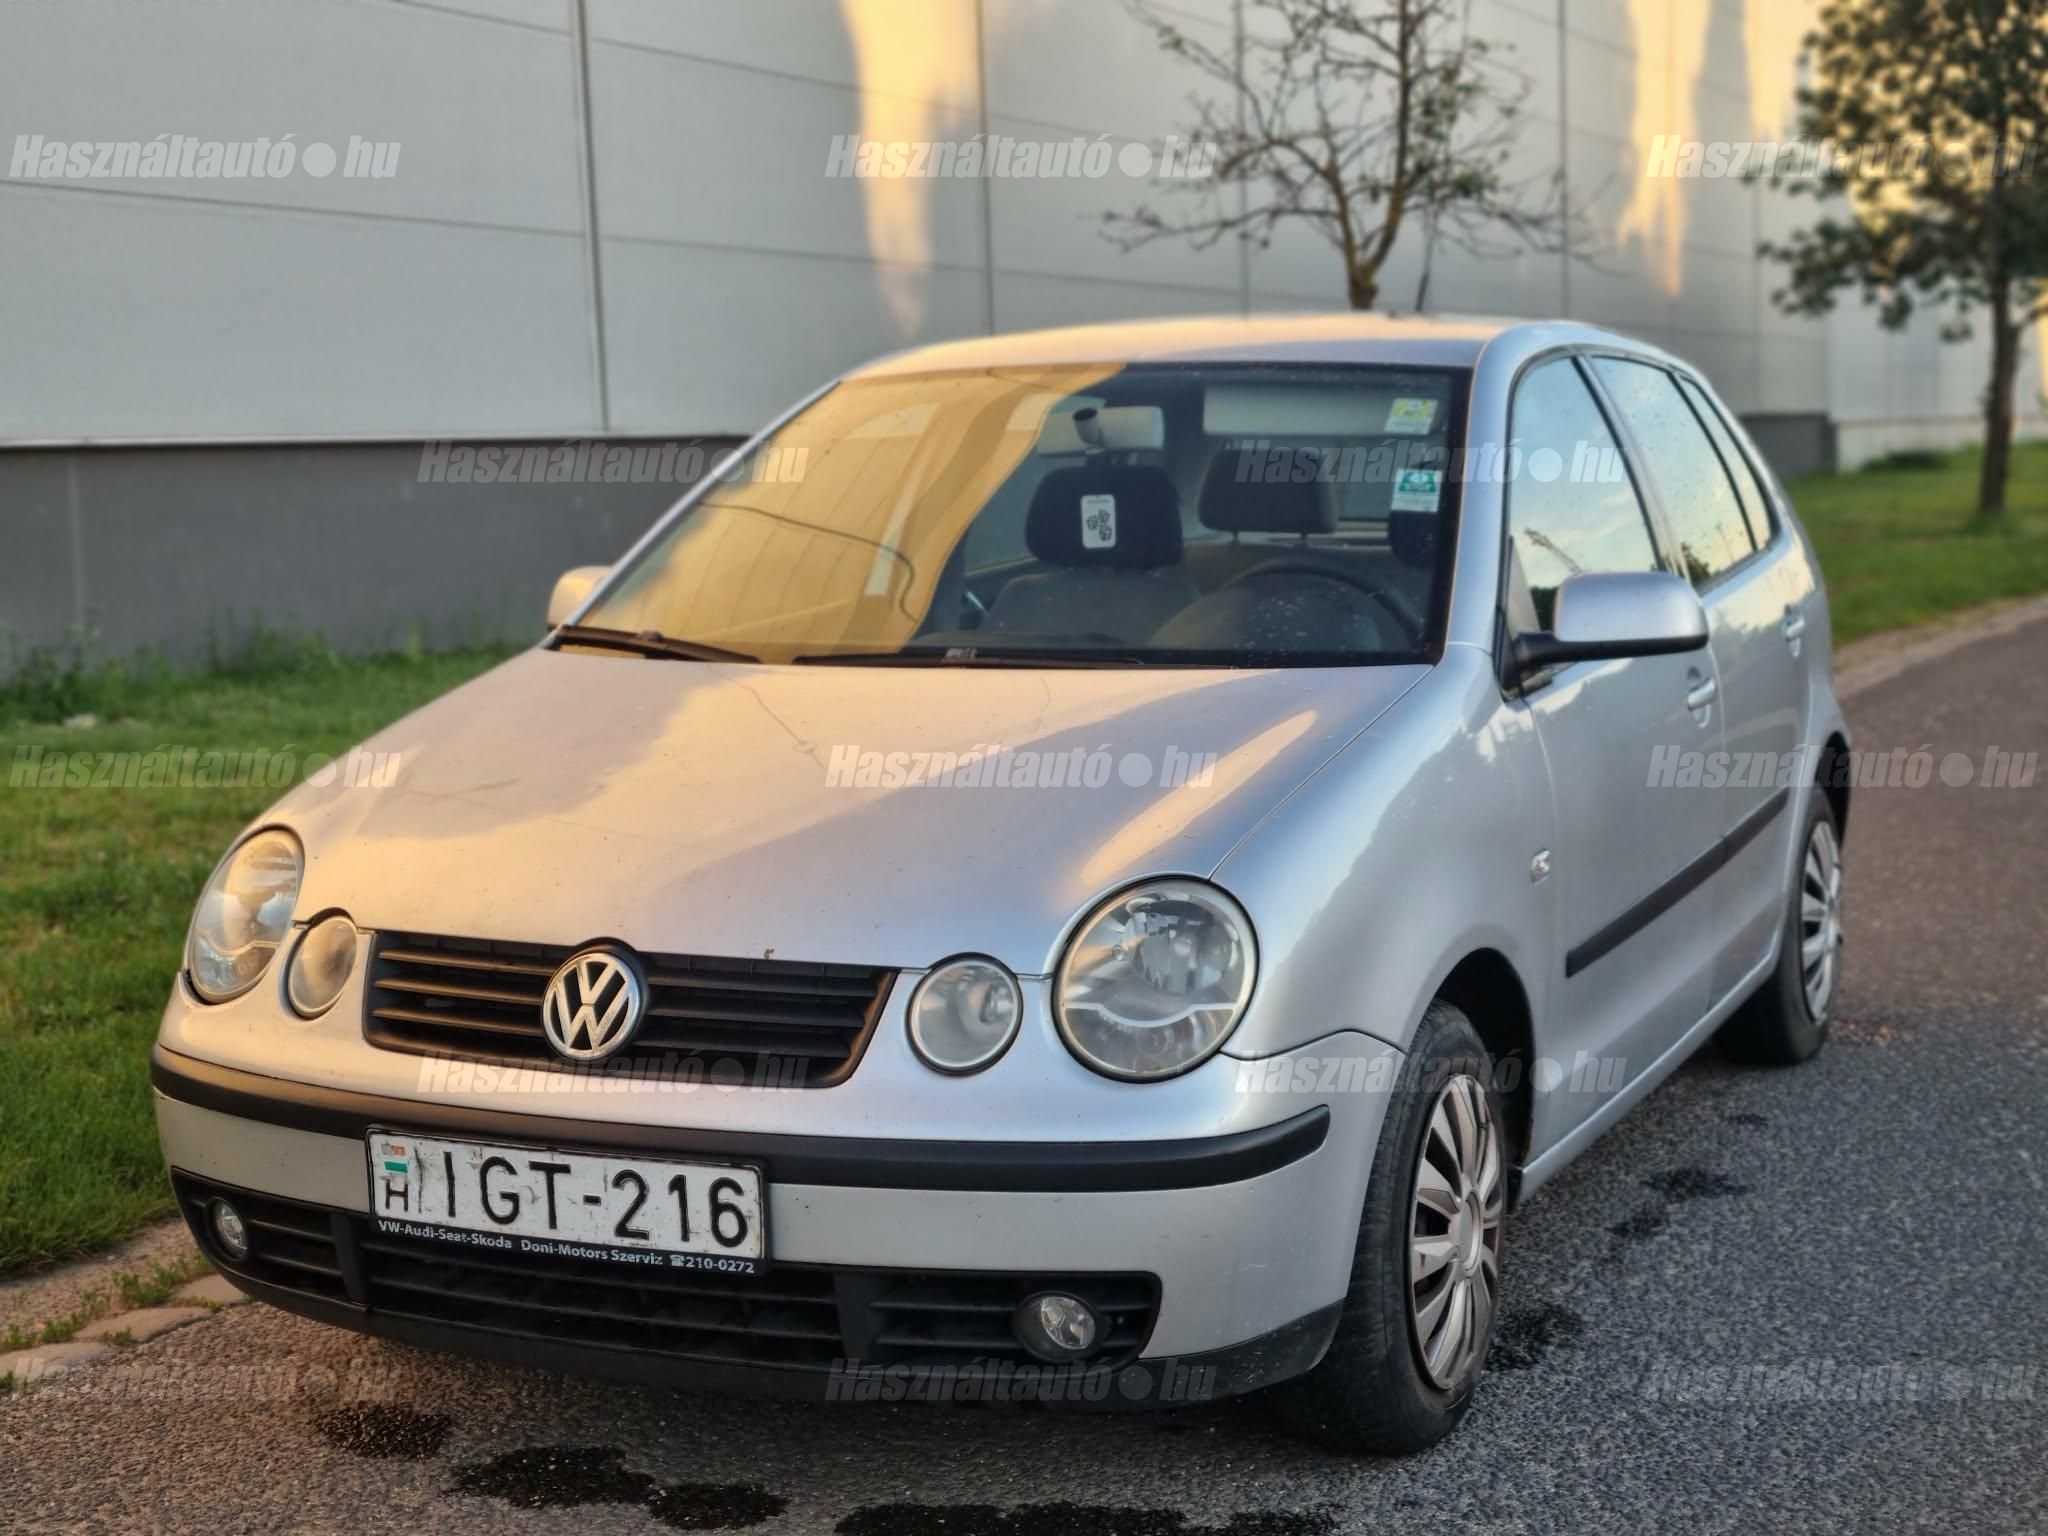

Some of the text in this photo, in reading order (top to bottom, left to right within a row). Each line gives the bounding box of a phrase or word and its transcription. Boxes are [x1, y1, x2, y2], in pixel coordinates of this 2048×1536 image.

[543, 952, 640, 1060] VW
[385, 1179, 409, 1213] H
[443, 1150, 750, 1248] IGT-216
[378, 1219, 512, 1249] VW-Audi-Seat-Skoda
[521, 1239, 608, 1260] Doni-Motors
[611, 1249, 664, 1266] Szerviz
